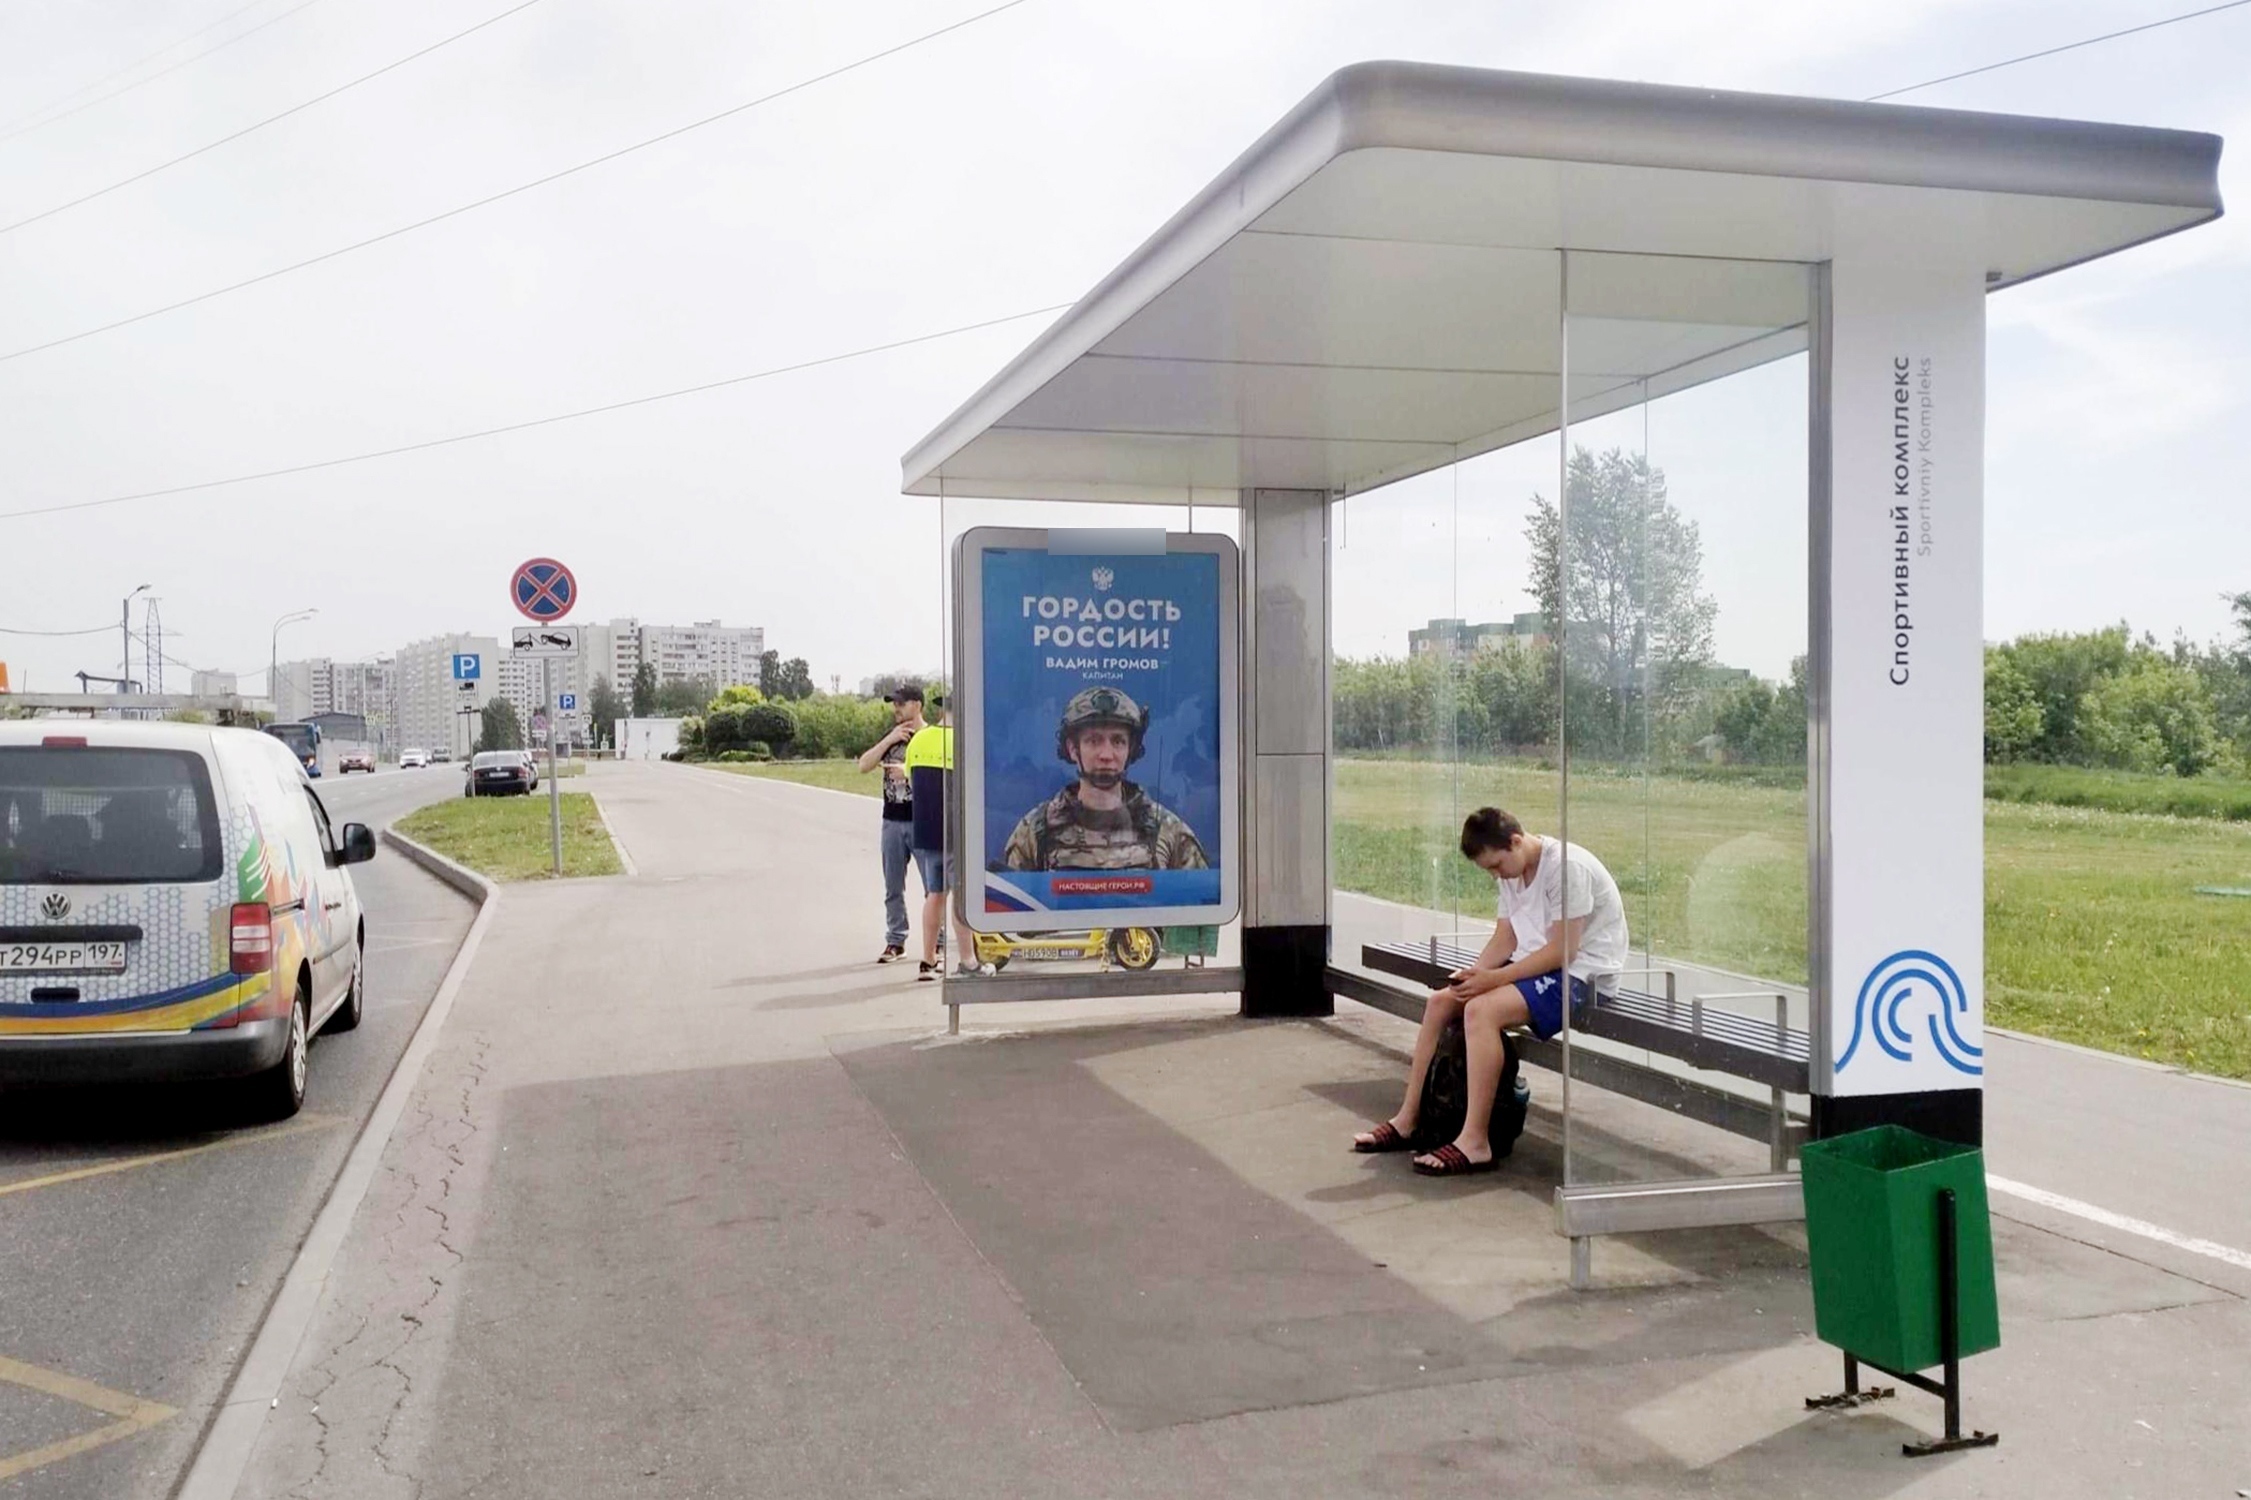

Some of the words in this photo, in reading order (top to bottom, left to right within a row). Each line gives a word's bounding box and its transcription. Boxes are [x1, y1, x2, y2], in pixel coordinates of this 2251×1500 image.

[1917, 357, 1933, 452] Kompleks
[1894, 356, 1910, 496] комплекс
[1917, 457, 1933, 557] Sportivniy
[1889, 505, 1914, 687] Спортивный
[1022, 596, 1182, 623] ГОРДОСТЬ
[1033, 625, 1171, 649] РОССИИ!
[460, 656, 476, 678] P
[1046, 657, 1098, 670] ВАДИМ
[1102, 657, 1159, 670] ГРОМОВ
[1082, 671, 1124, 680] КАПИТАН
[563, 695, 573, 708] P
[88, 944, 120, 960] 197
